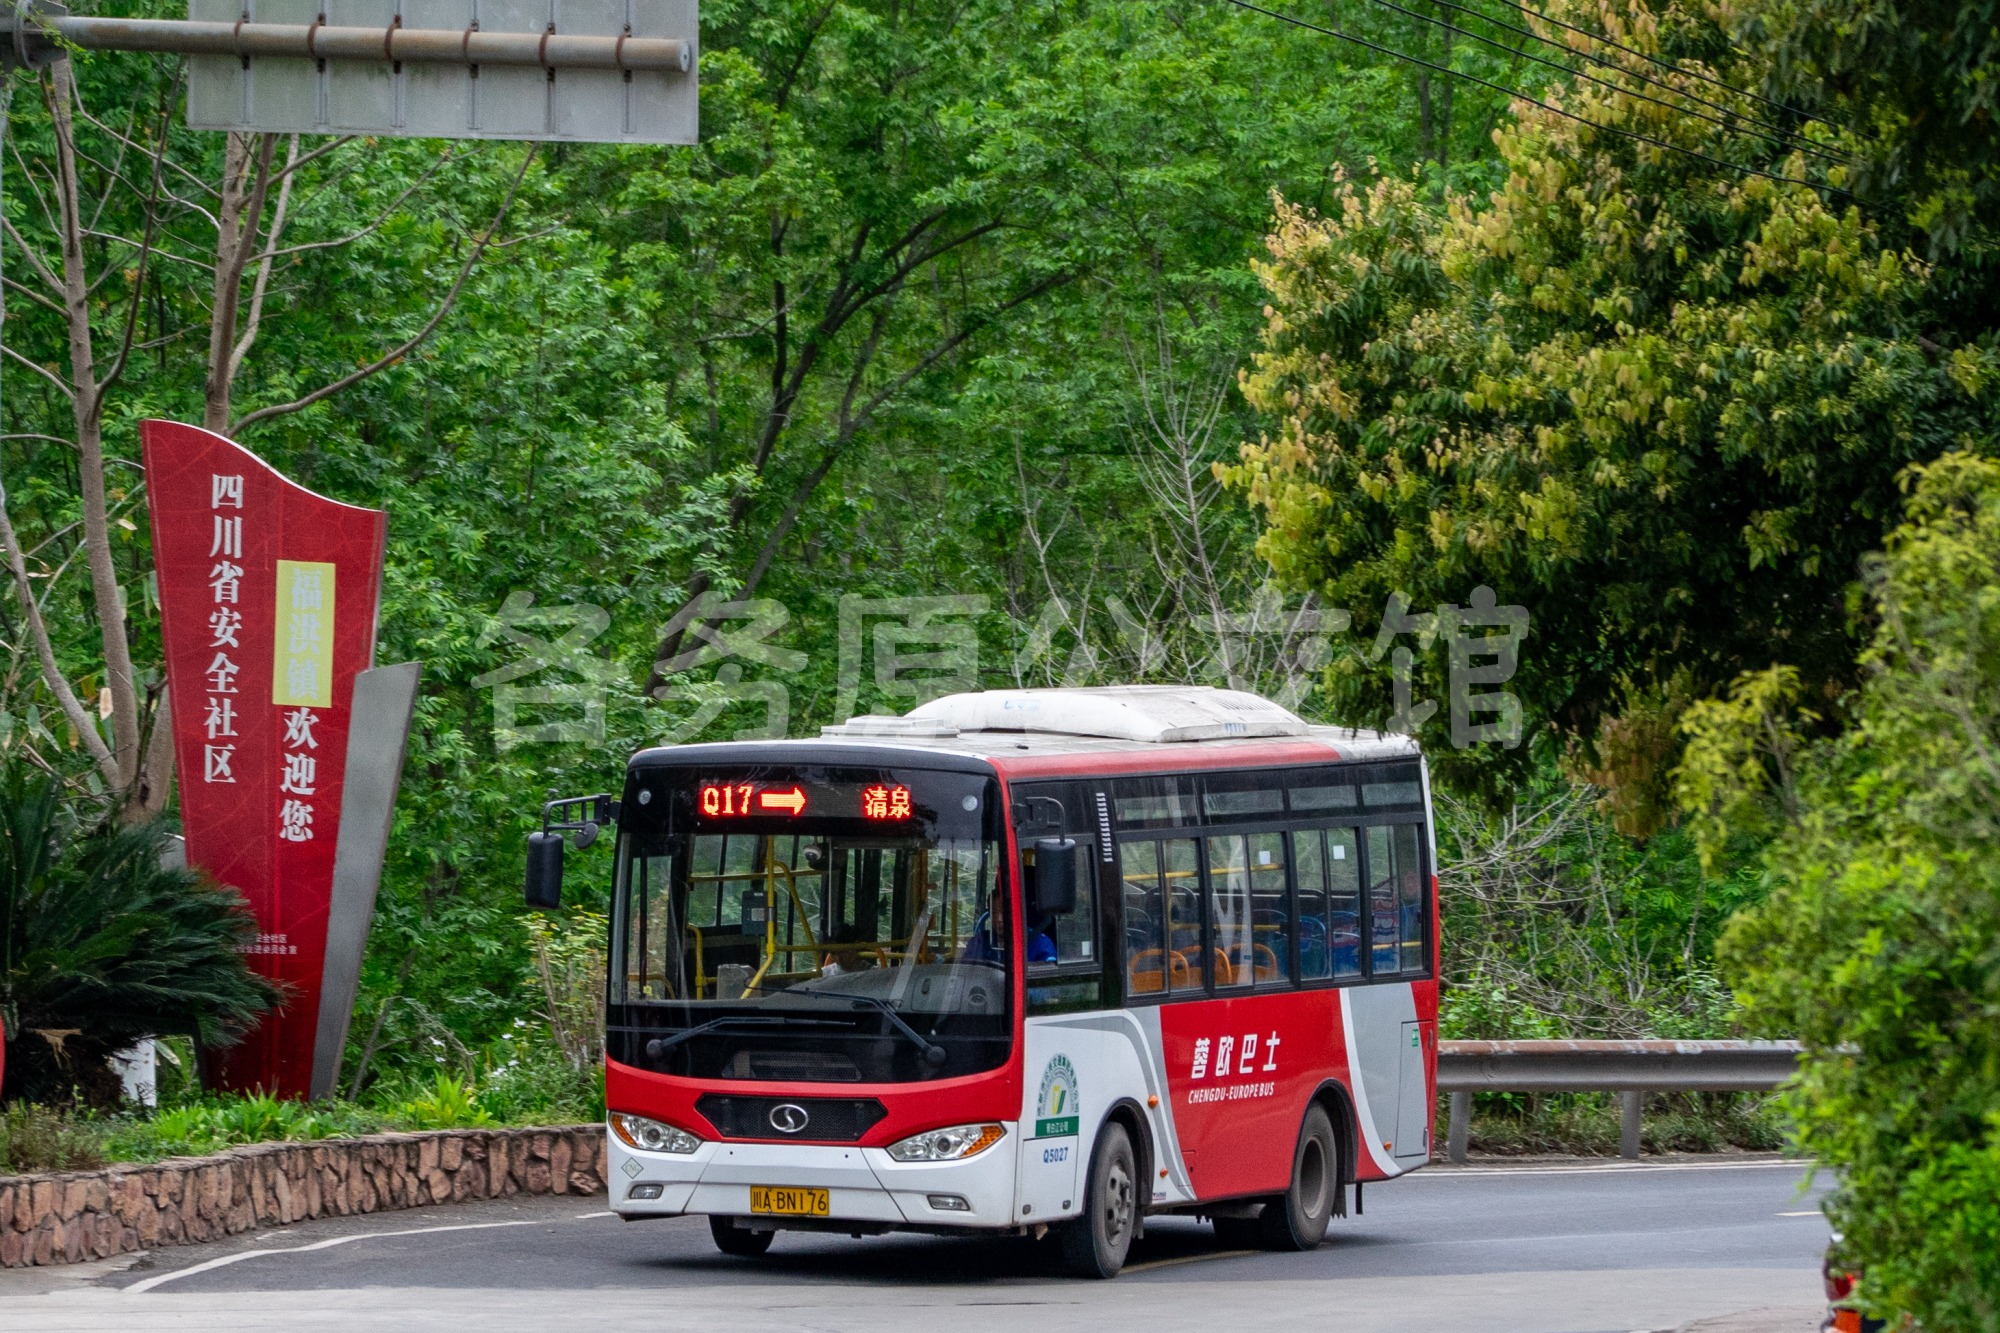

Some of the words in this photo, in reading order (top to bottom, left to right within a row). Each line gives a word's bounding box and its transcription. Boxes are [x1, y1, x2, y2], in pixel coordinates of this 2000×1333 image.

[203, 473, 245, 784] 四川省安全社区
[703, 785, 753, 815] Q17
[864, 786, 910, 818] 清泉
[1191, 1030, 1281, 1079] 蓉欧巴士
[1043, 1147, 1069, 1164] Q5027
